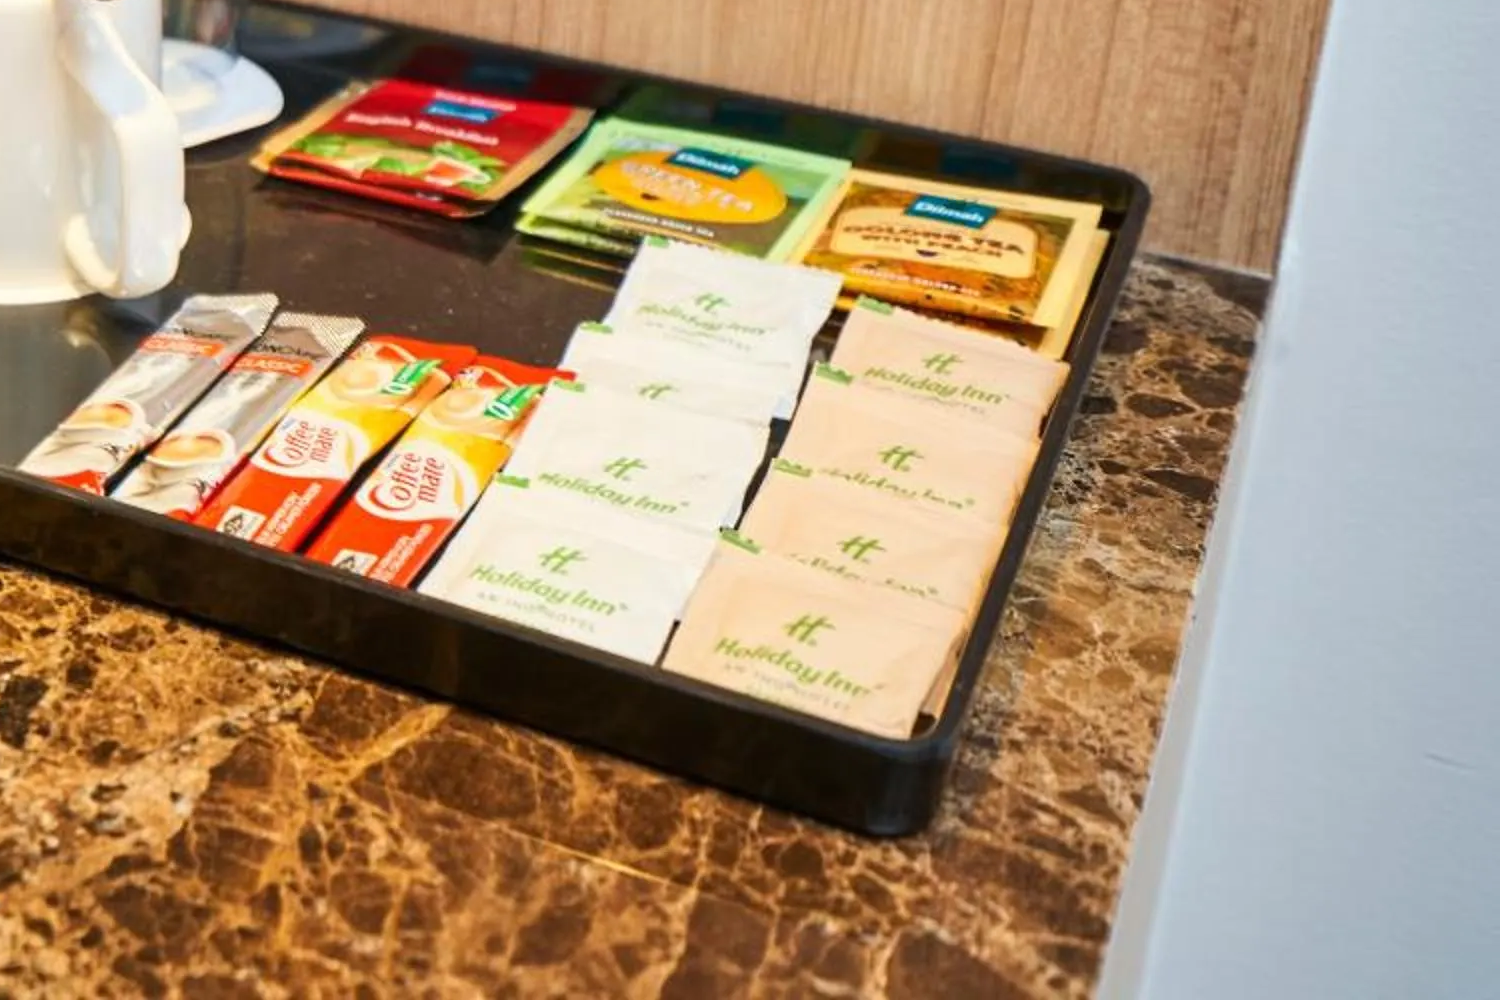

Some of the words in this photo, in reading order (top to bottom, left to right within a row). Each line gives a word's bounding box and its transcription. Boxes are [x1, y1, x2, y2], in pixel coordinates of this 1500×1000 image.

[675, 151, 741, 176] Dilmah
[914, 200, 985, 224] Dilmah
[863, 367, 959, 398] Holiday
[263, 420, 312, 468] Coffee
[309, 427, 338, 464] mate
[368, 452, 421, 512] Coffee
[417, 456, 445, 504] mate
[538, 472, 632, 506] Holiday
[633, 495, 679, 514] Inn
[469, 563, 570, 604] Holiday
[571, 589, 617, 617] Inn
[714, 637, 822, 685] Holiday
